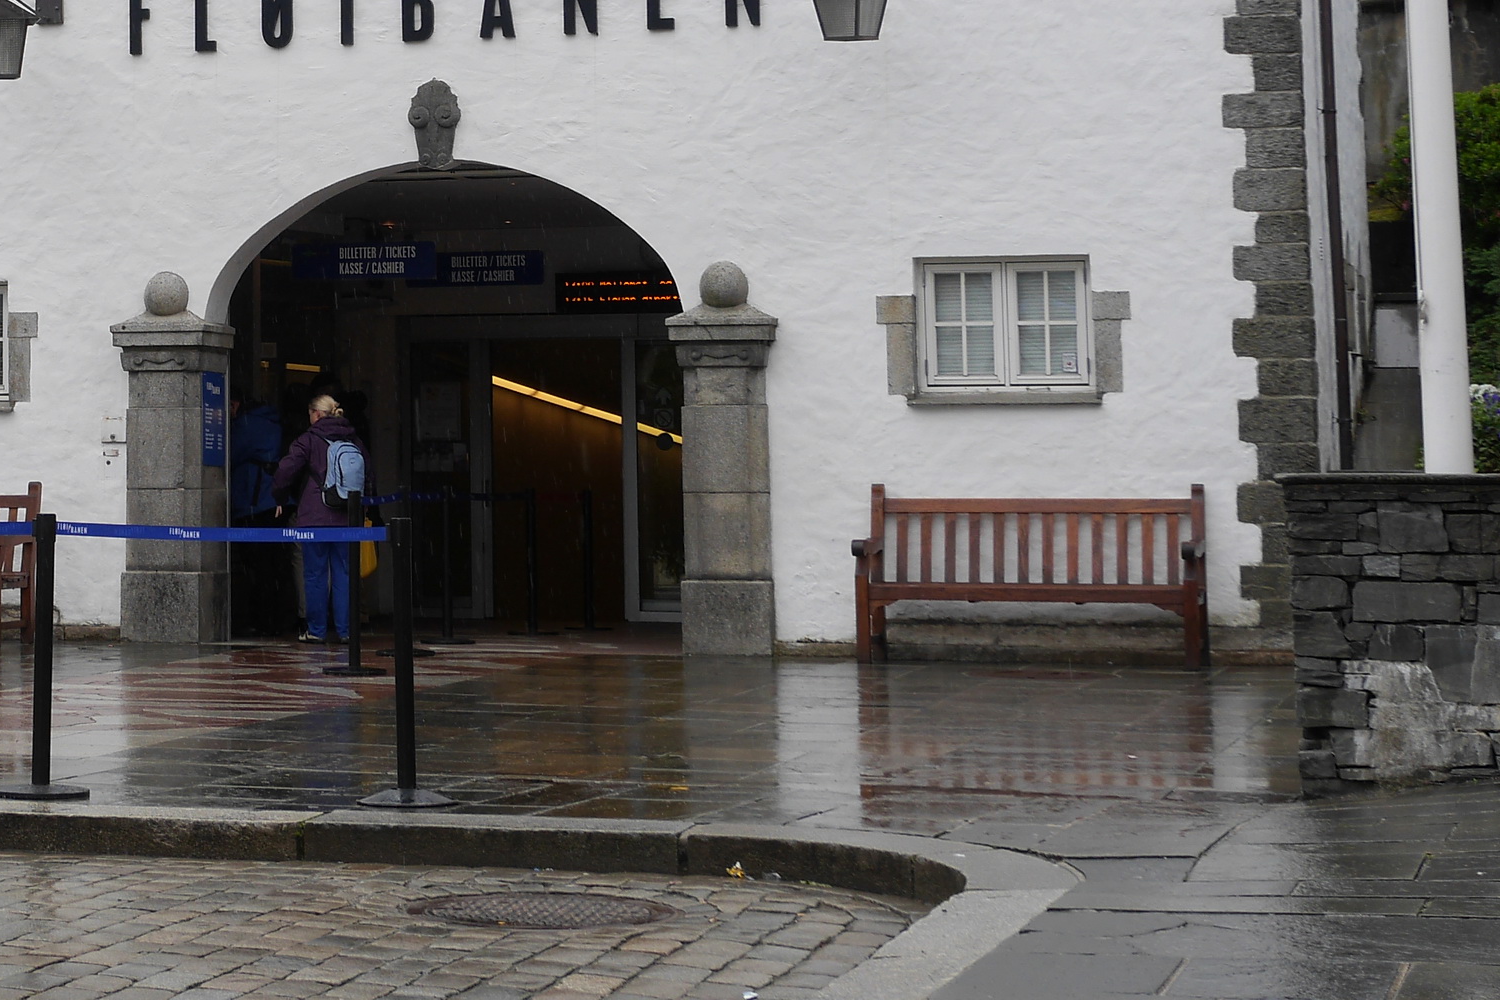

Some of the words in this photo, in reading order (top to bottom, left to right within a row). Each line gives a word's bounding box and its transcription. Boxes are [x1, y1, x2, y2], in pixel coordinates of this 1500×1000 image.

[339, 246, 377, 259] BILLETTER
[385, 245, 416, 259] TICKETS
[339, 262, 364, 275] KASSE
[371, 261, 405, 274] CASHIER
[451, 255, 488, 268] BILLETTER
[495, 254, 526, 267] TICKETS
[451, 271, 475, 283] KASSE
[483, 269, 515, 282] CASHIER
